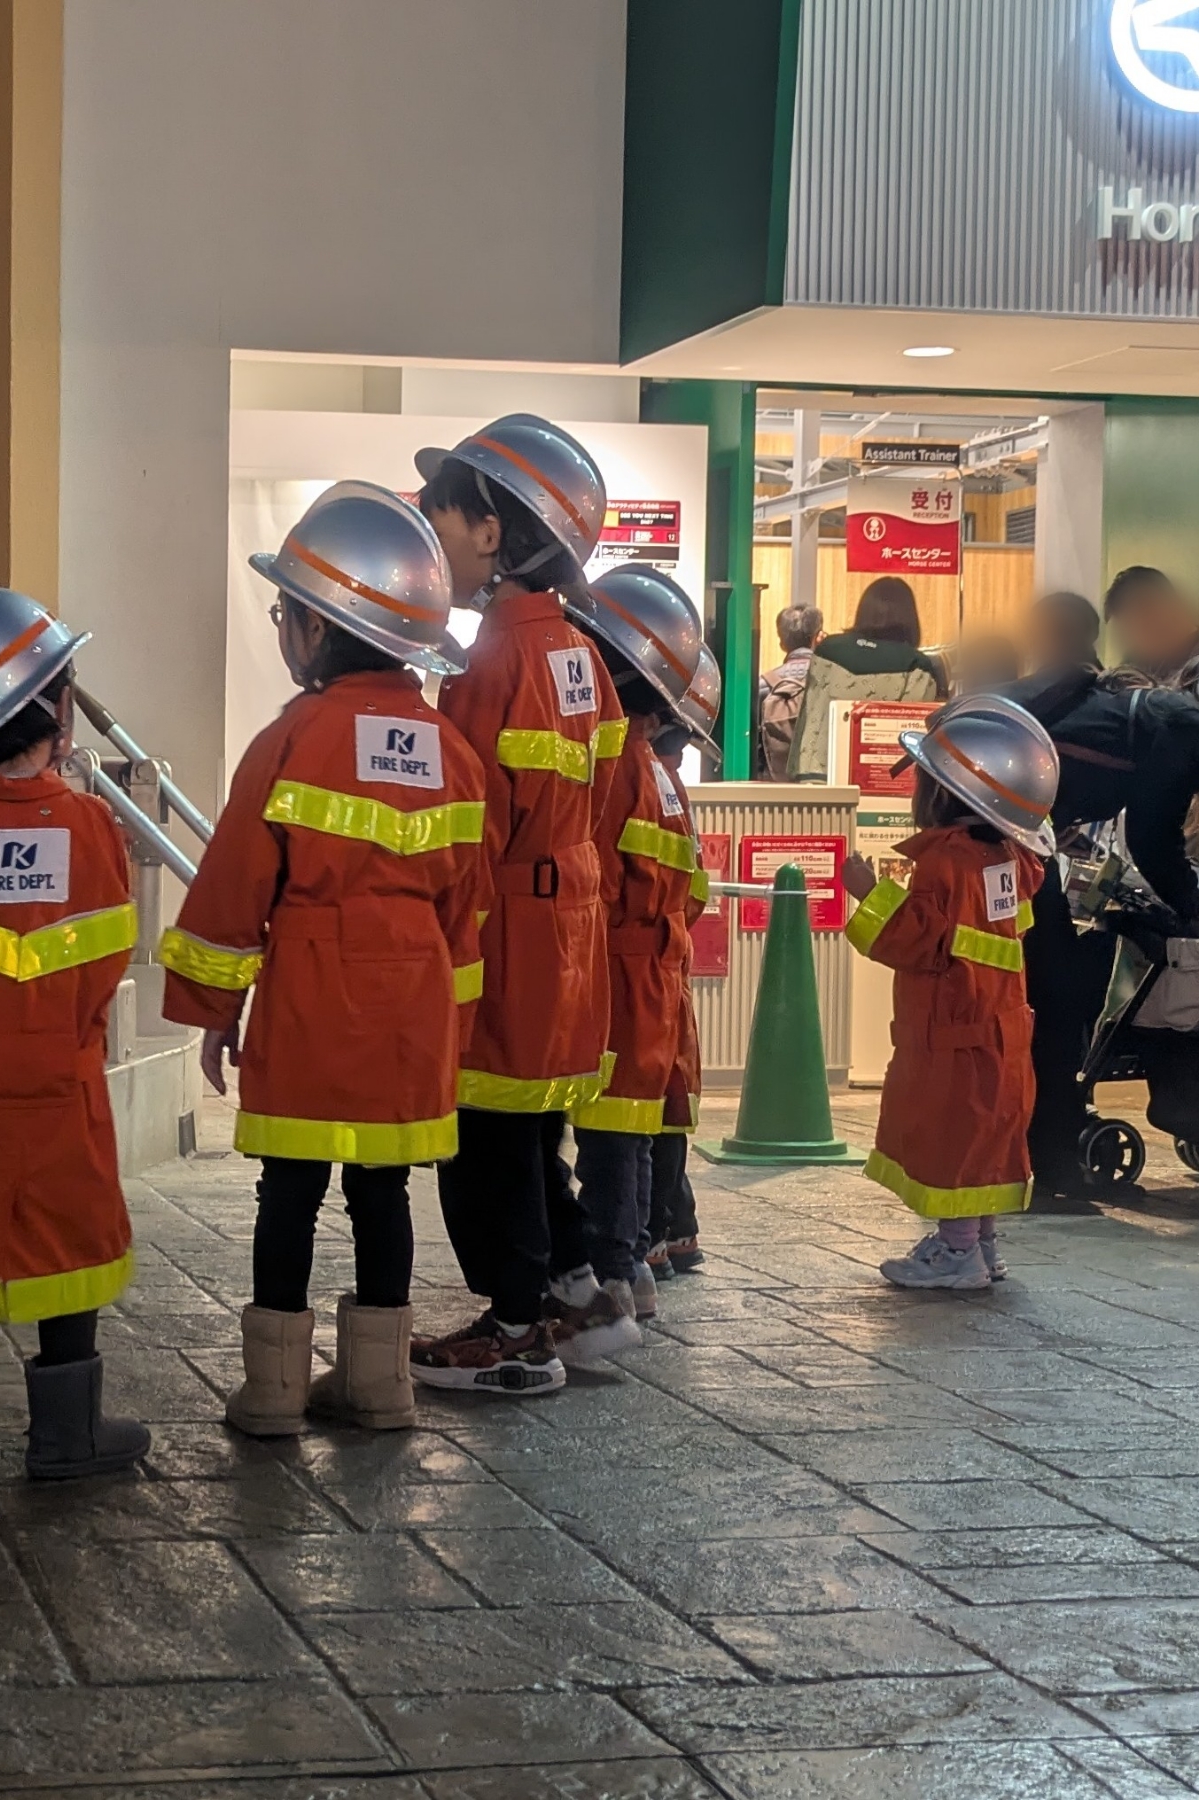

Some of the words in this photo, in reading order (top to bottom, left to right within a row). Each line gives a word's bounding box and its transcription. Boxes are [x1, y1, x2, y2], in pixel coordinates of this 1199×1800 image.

[864, 447, 917, 461] Assistant
[918, 448, 958, 462] Trainer
[911, 490, 953, 511] 受付
[912, 511, 950, 519] RECEPTION
[881, 546, 952, 560] ホースセンター
[370, 755, 398, 773] FIRE
[400, 759, 431, 777] DEPT.
[18, 873, 56, 890] DEPT.
[993, 897, 1009, 911] FIRE
